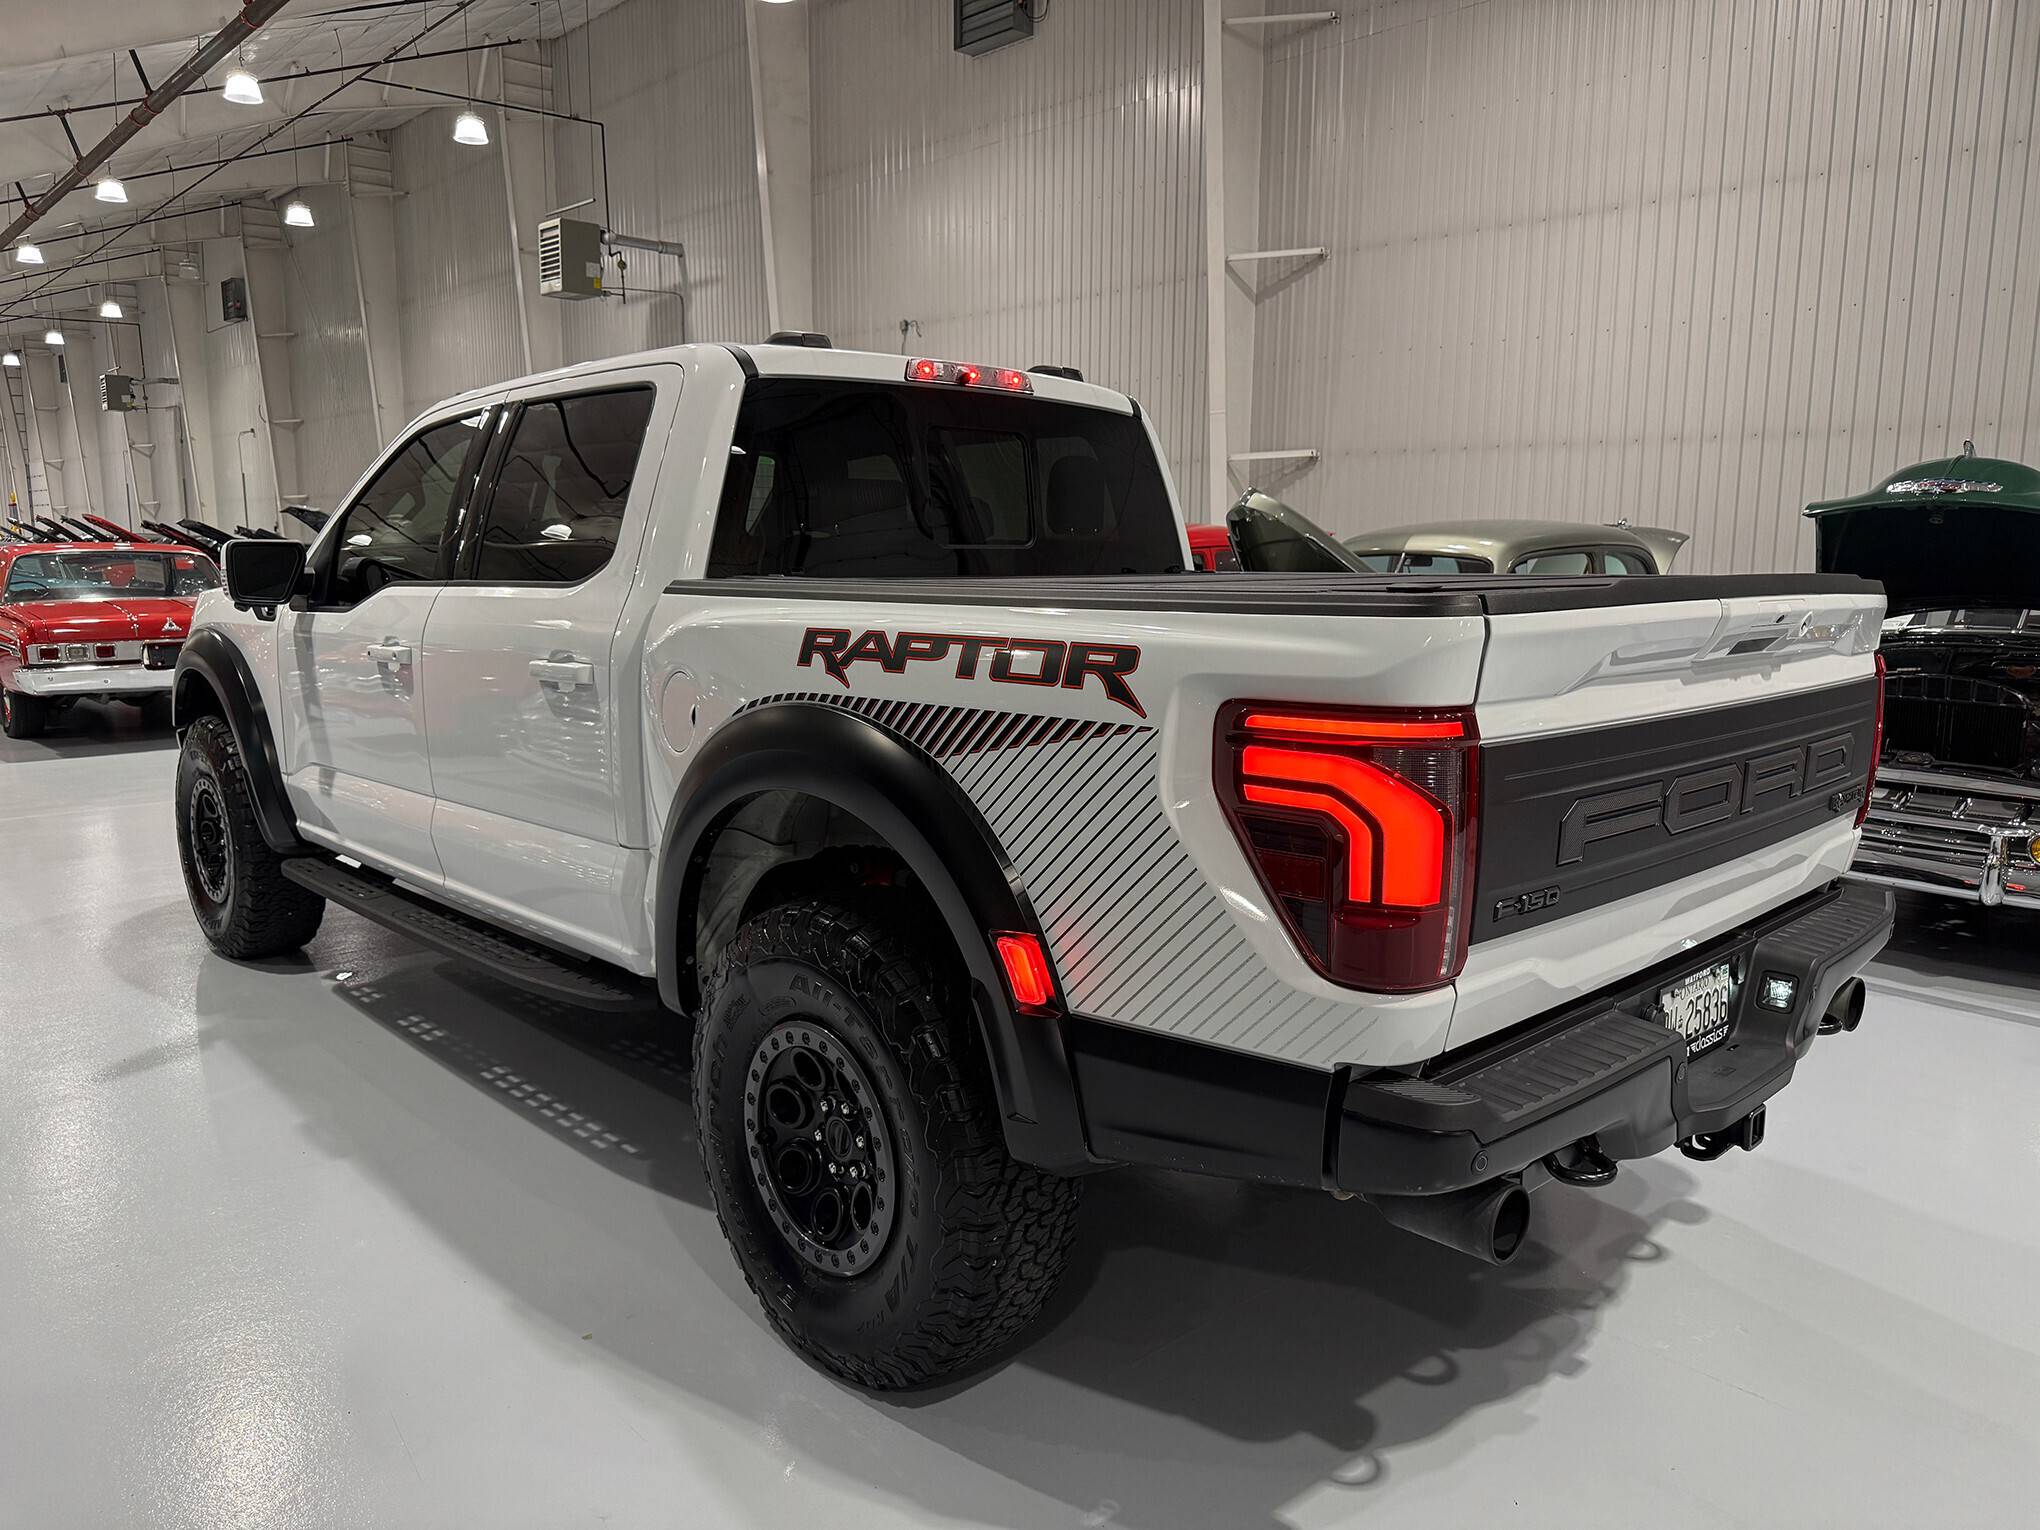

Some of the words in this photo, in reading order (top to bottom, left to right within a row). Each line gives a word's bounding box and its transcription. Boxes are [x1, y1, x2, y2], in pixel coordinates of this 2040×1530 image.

[796, 627, 1147, 719] RAPTOR
[1555, 731, 1854, 867] FORD
[1493, 885, 1561, 922] F-150
[1685, 985, 1728, 1040] 25836
